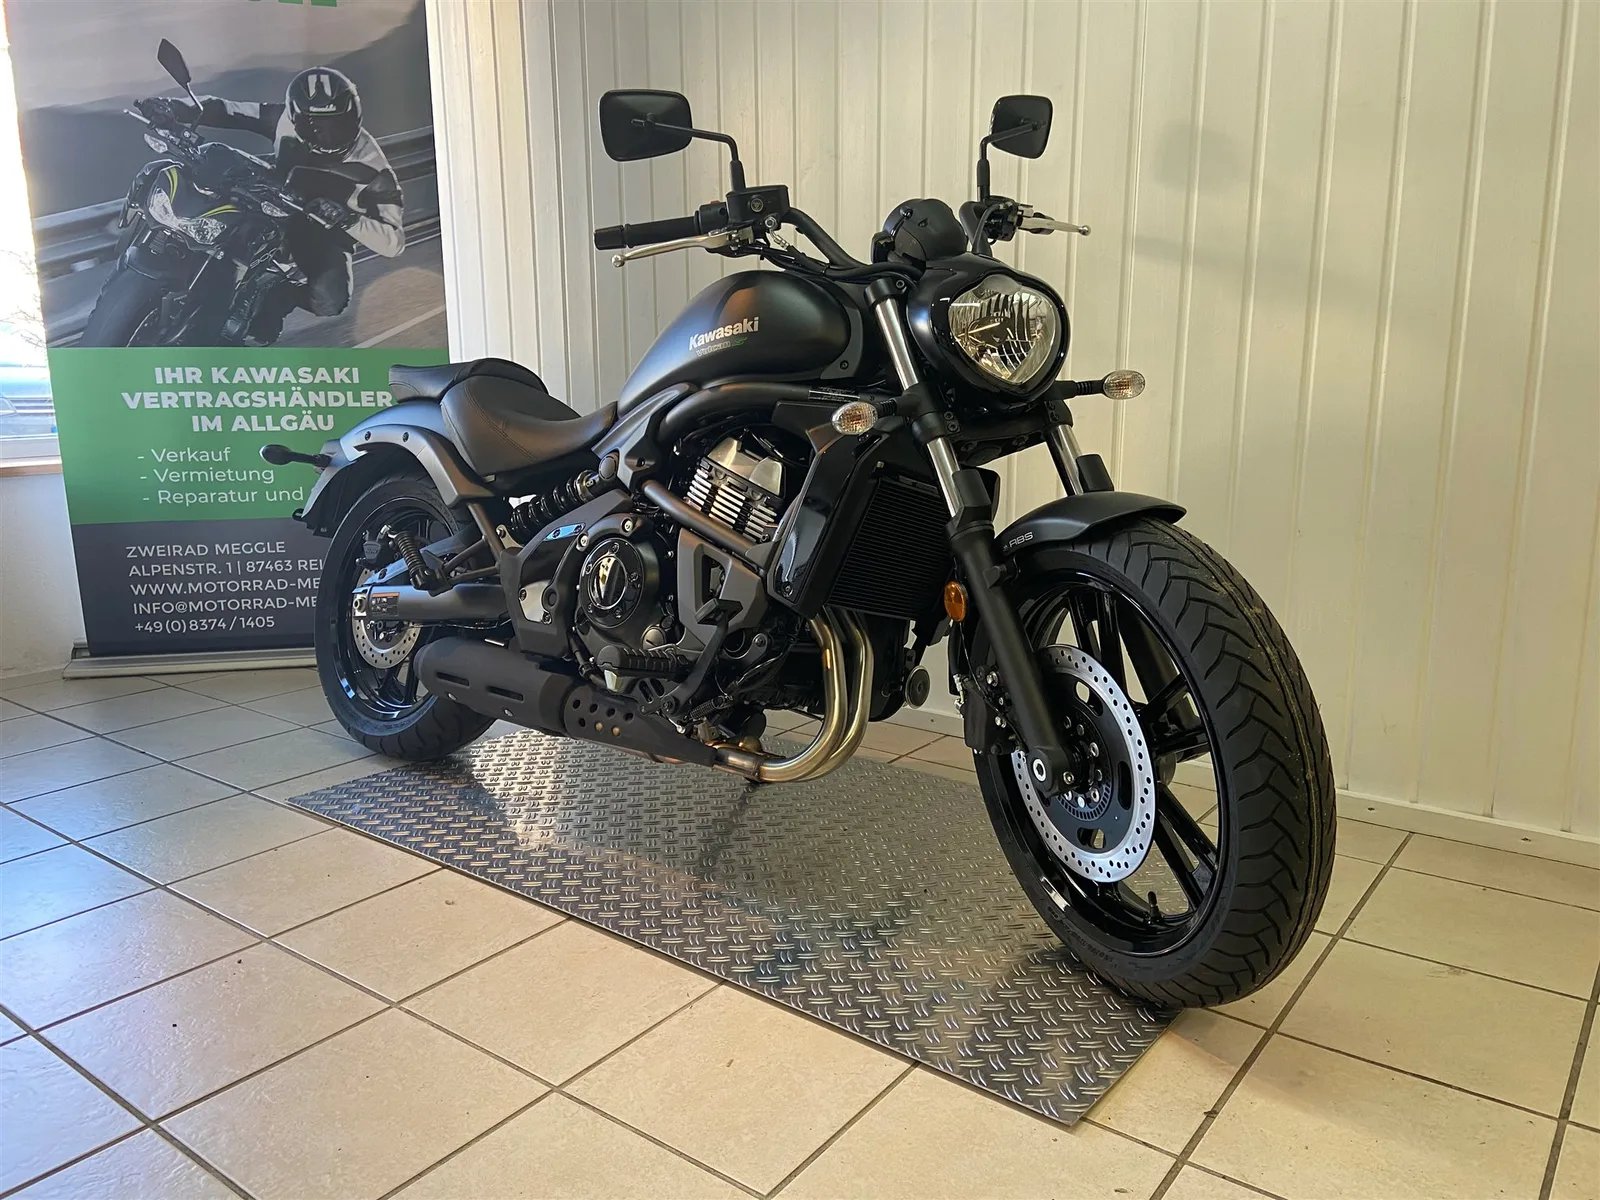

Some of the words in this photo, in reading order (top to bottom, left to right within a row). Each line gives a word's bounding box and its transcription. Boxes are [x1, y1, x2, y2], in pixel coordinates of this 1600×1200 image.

[689, 317, 759, 351] Kawasaki
[154, 367, 204, 385] IHR
[212, 367, 360, 384] KAWASAKI
[121, 386, 393, 409] VERTRAGSHÄNDLER
[192, 415, 223, 432] IM
[231, 410, 335, 432] ALLGÄU
[151, 447, 231, 463] Verkauf
[153, 467, 275, 485] Vermietung
[157, 489, 258, 507] Reparatur
[265, 487, 304, 502] und
[1009, 531, 1034, 548] ABS
[126, 544, 209, 558] ZWEIRAD
[215, 541, 286, 556] MEGGLE
[128, 562, 222, 577] ALPENSTR.
[246, 559, 293, 573] 87463
[130, 577, 320, 596] WWW.MOTORRAD-ME
